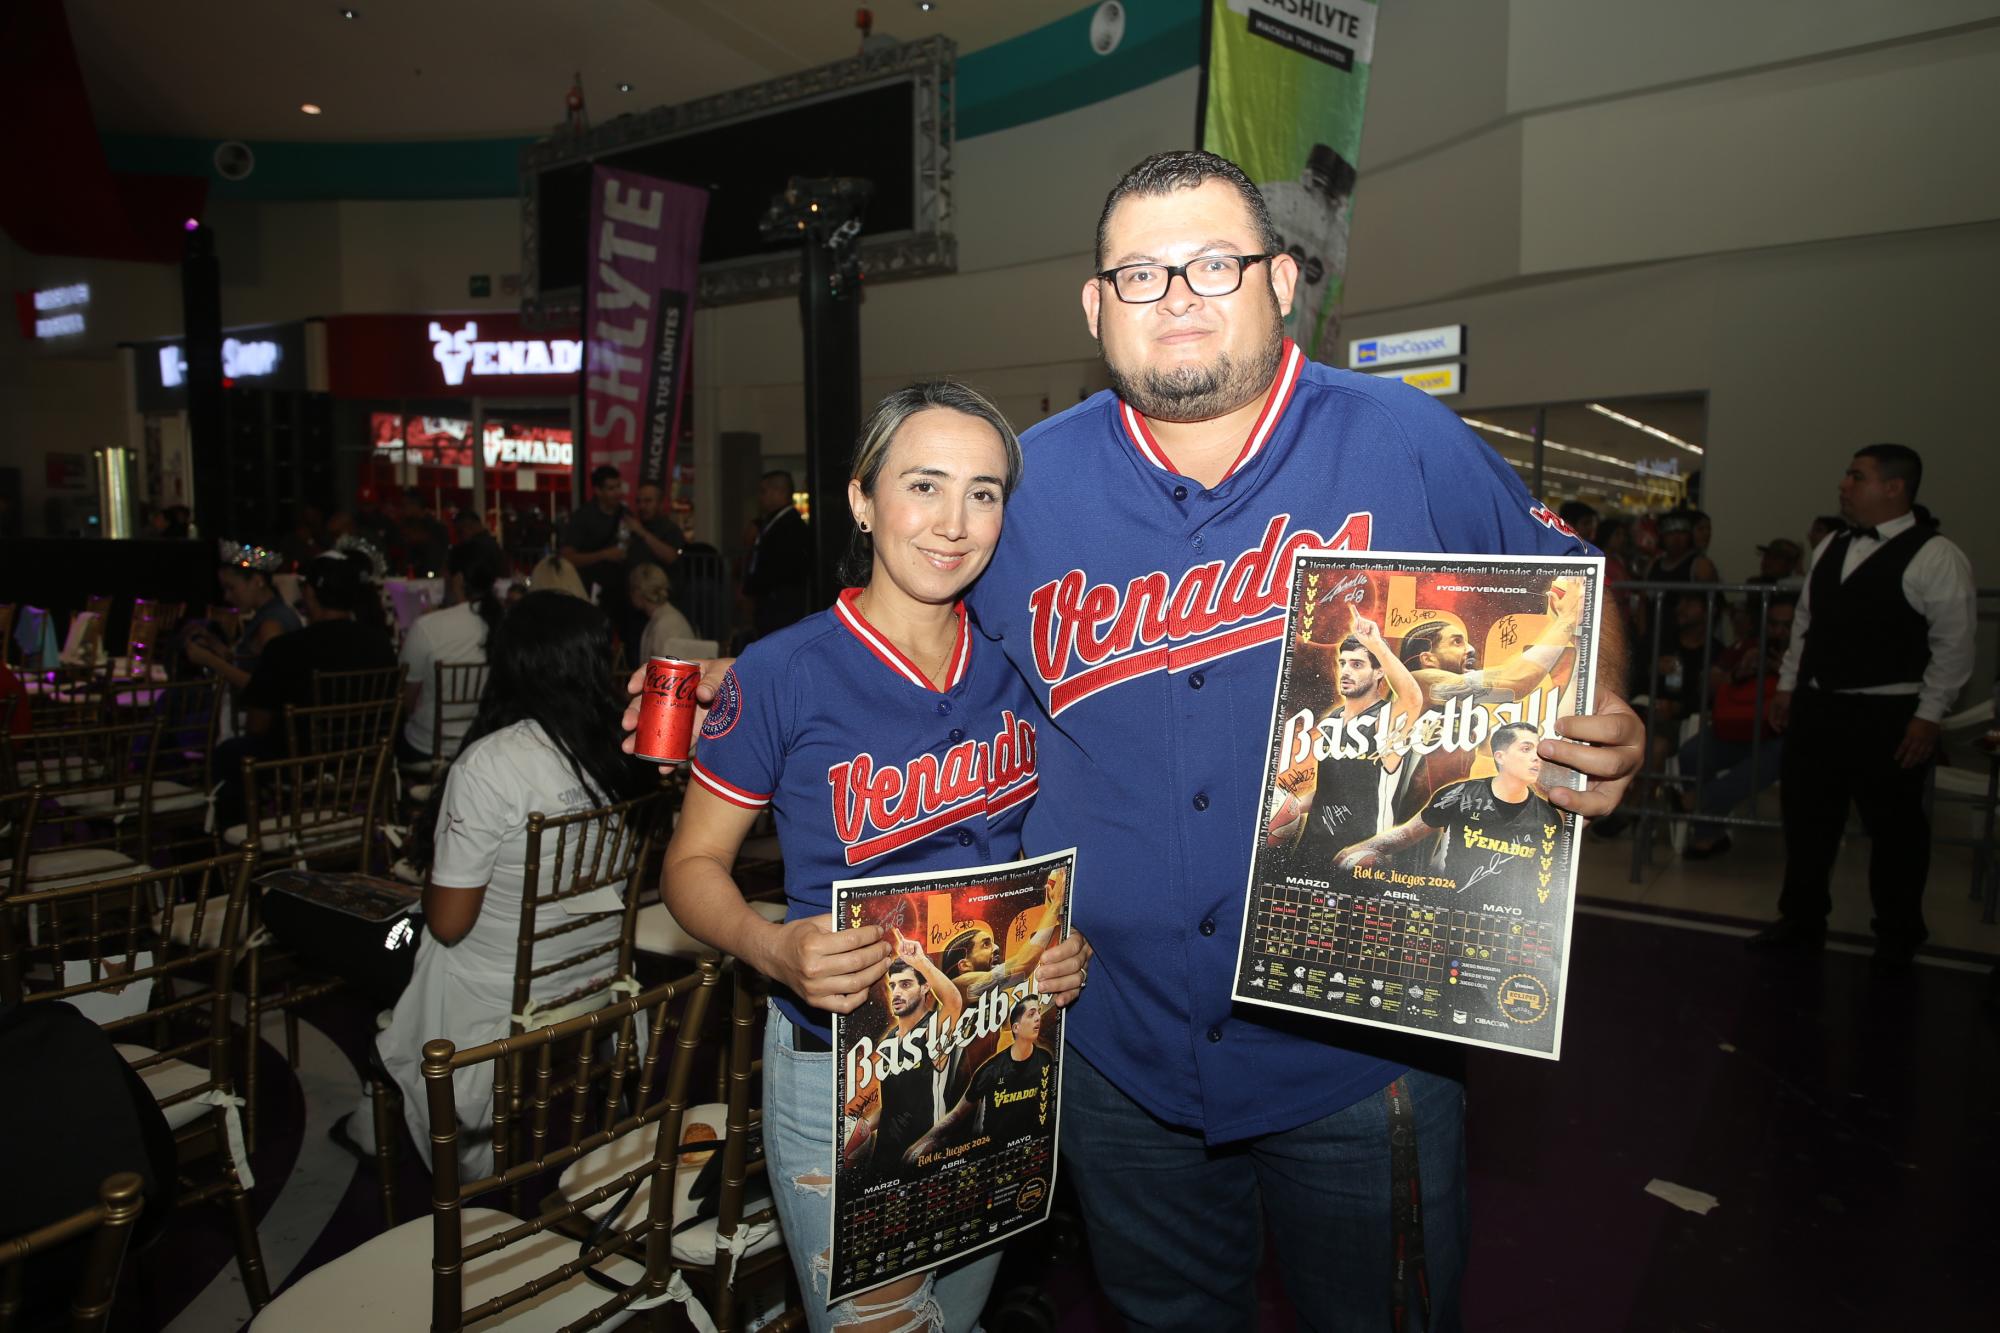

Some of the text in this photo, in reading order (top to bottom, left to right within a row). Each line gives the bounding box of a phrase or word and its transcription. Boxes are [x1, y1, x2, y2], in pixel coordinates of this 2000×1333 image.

[428, 321, 584, 386] VENAD
[657, 375, 671, 406] TUS
[483, 427, 573, 468] VENADO
[648, 408, 669, 480] HACKEA
[1436, 585, 1528, 594] #YOSOYVENADOS
[828, 710, 1036, 844] Venado
[1463, 825, 1537, 859] VENADOS
[1285, 876, 1330, 889] MARZO
[1353, 865, 1457, 889] Rol de Juegos 2024
[1383, 889, 1420, 902] ABRIL
[1482, 903, 1522, 916] MAYO
[971, 1136, 991, 1148] 2024
[1007, 1135, 1031, 1148] MAYO
[941, 1158, 967, 1171] ABRIL
[864, 1179, 900, 1195] MARZO
